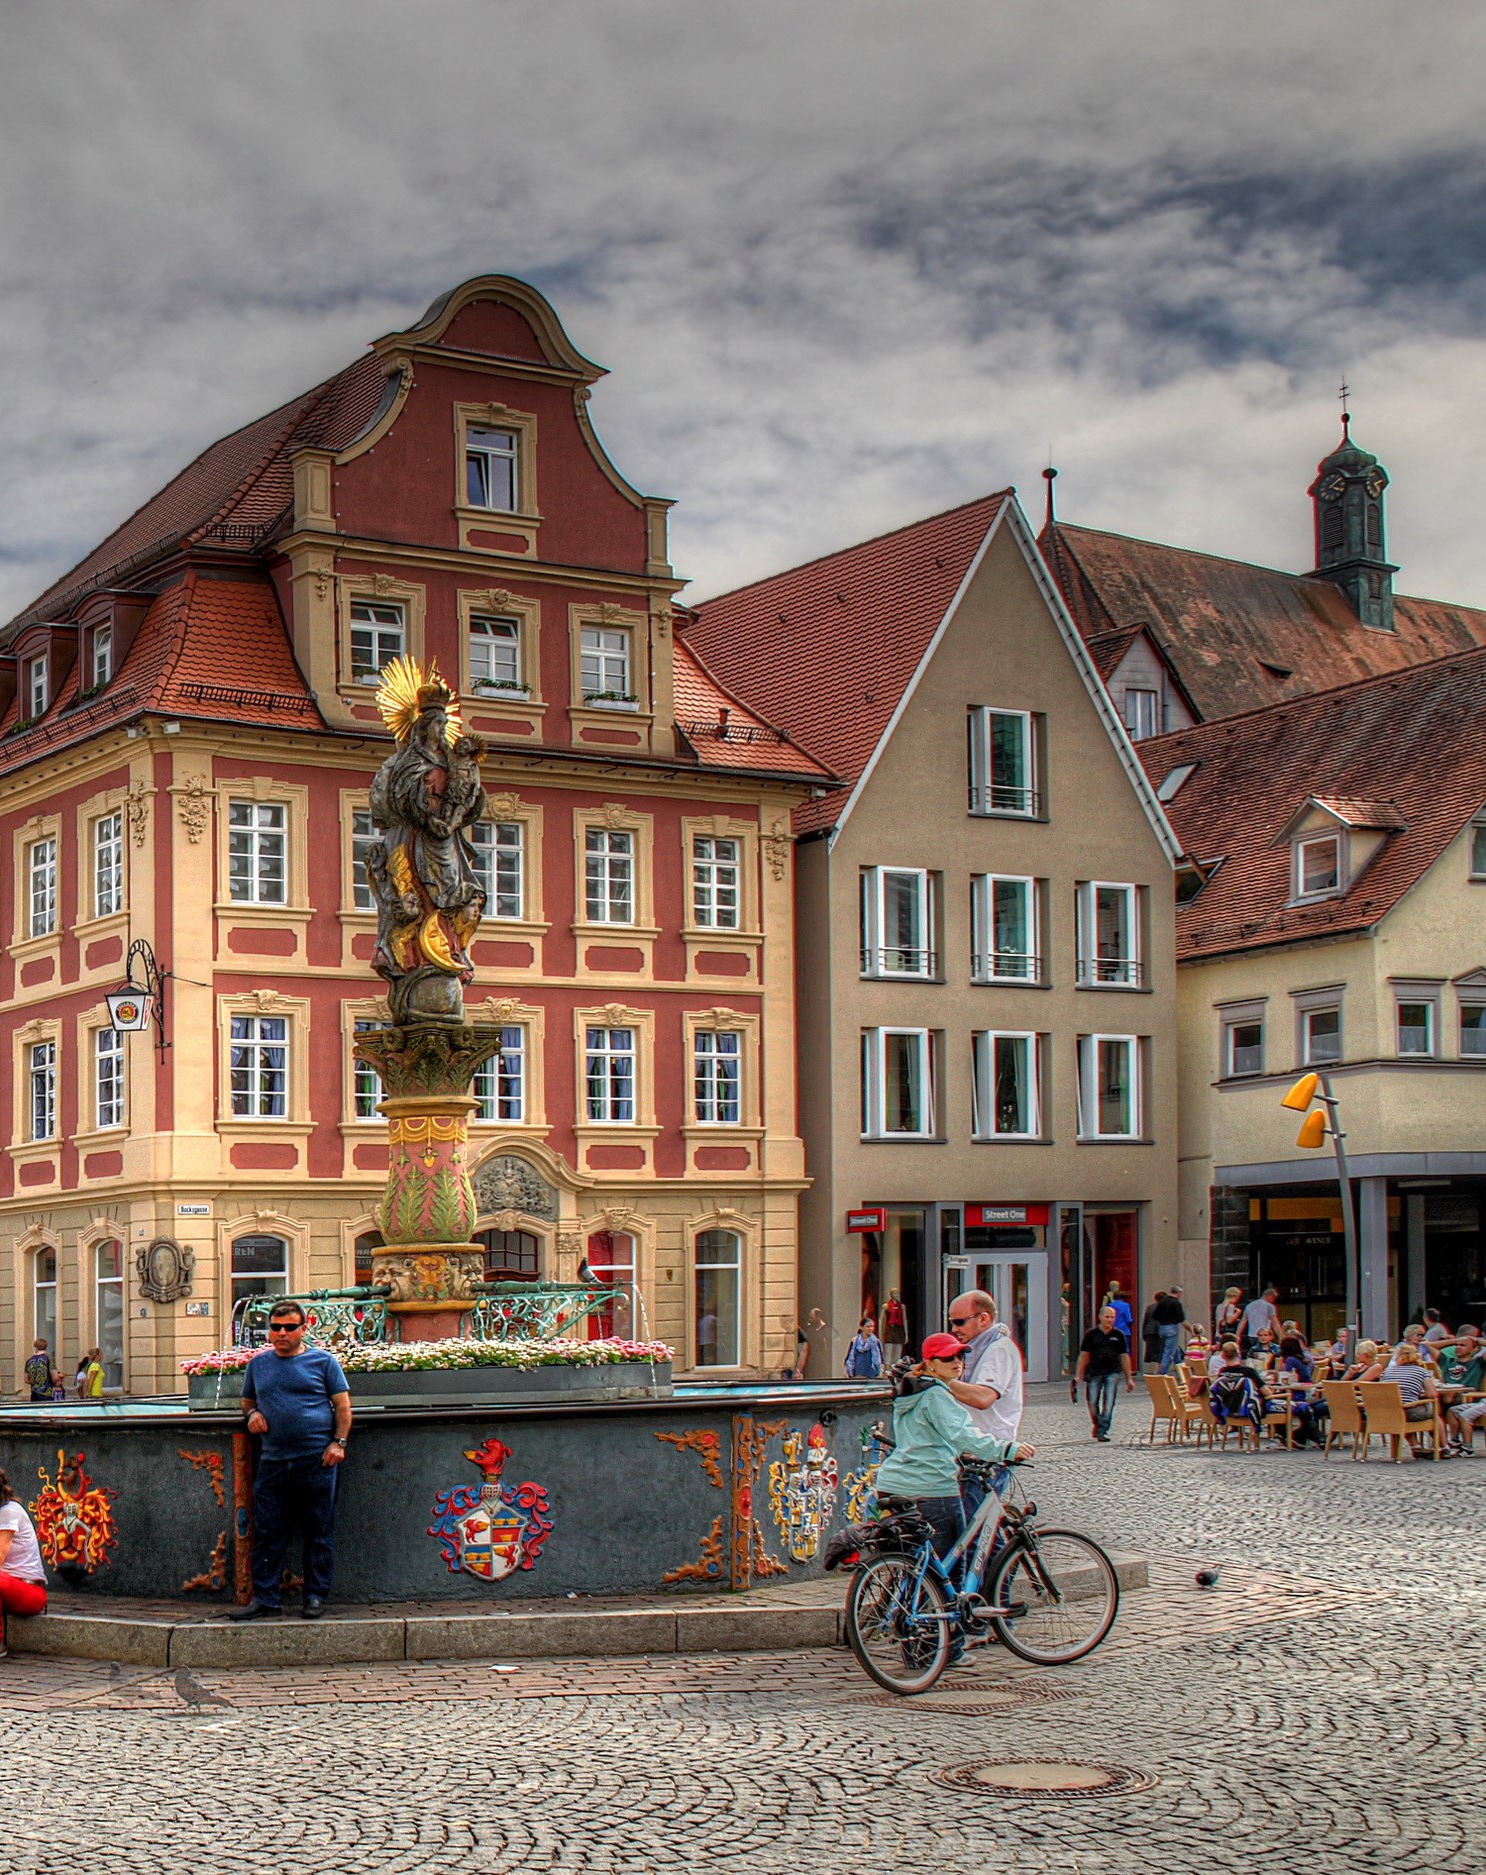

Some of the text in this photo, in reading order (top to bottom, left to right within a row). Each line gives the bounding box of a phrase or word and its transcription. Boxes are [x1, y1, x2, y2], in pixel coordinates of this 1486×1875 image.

[985, 1208, 1026, 1219] Street One
[851, 1217, 866, 1225] Street
